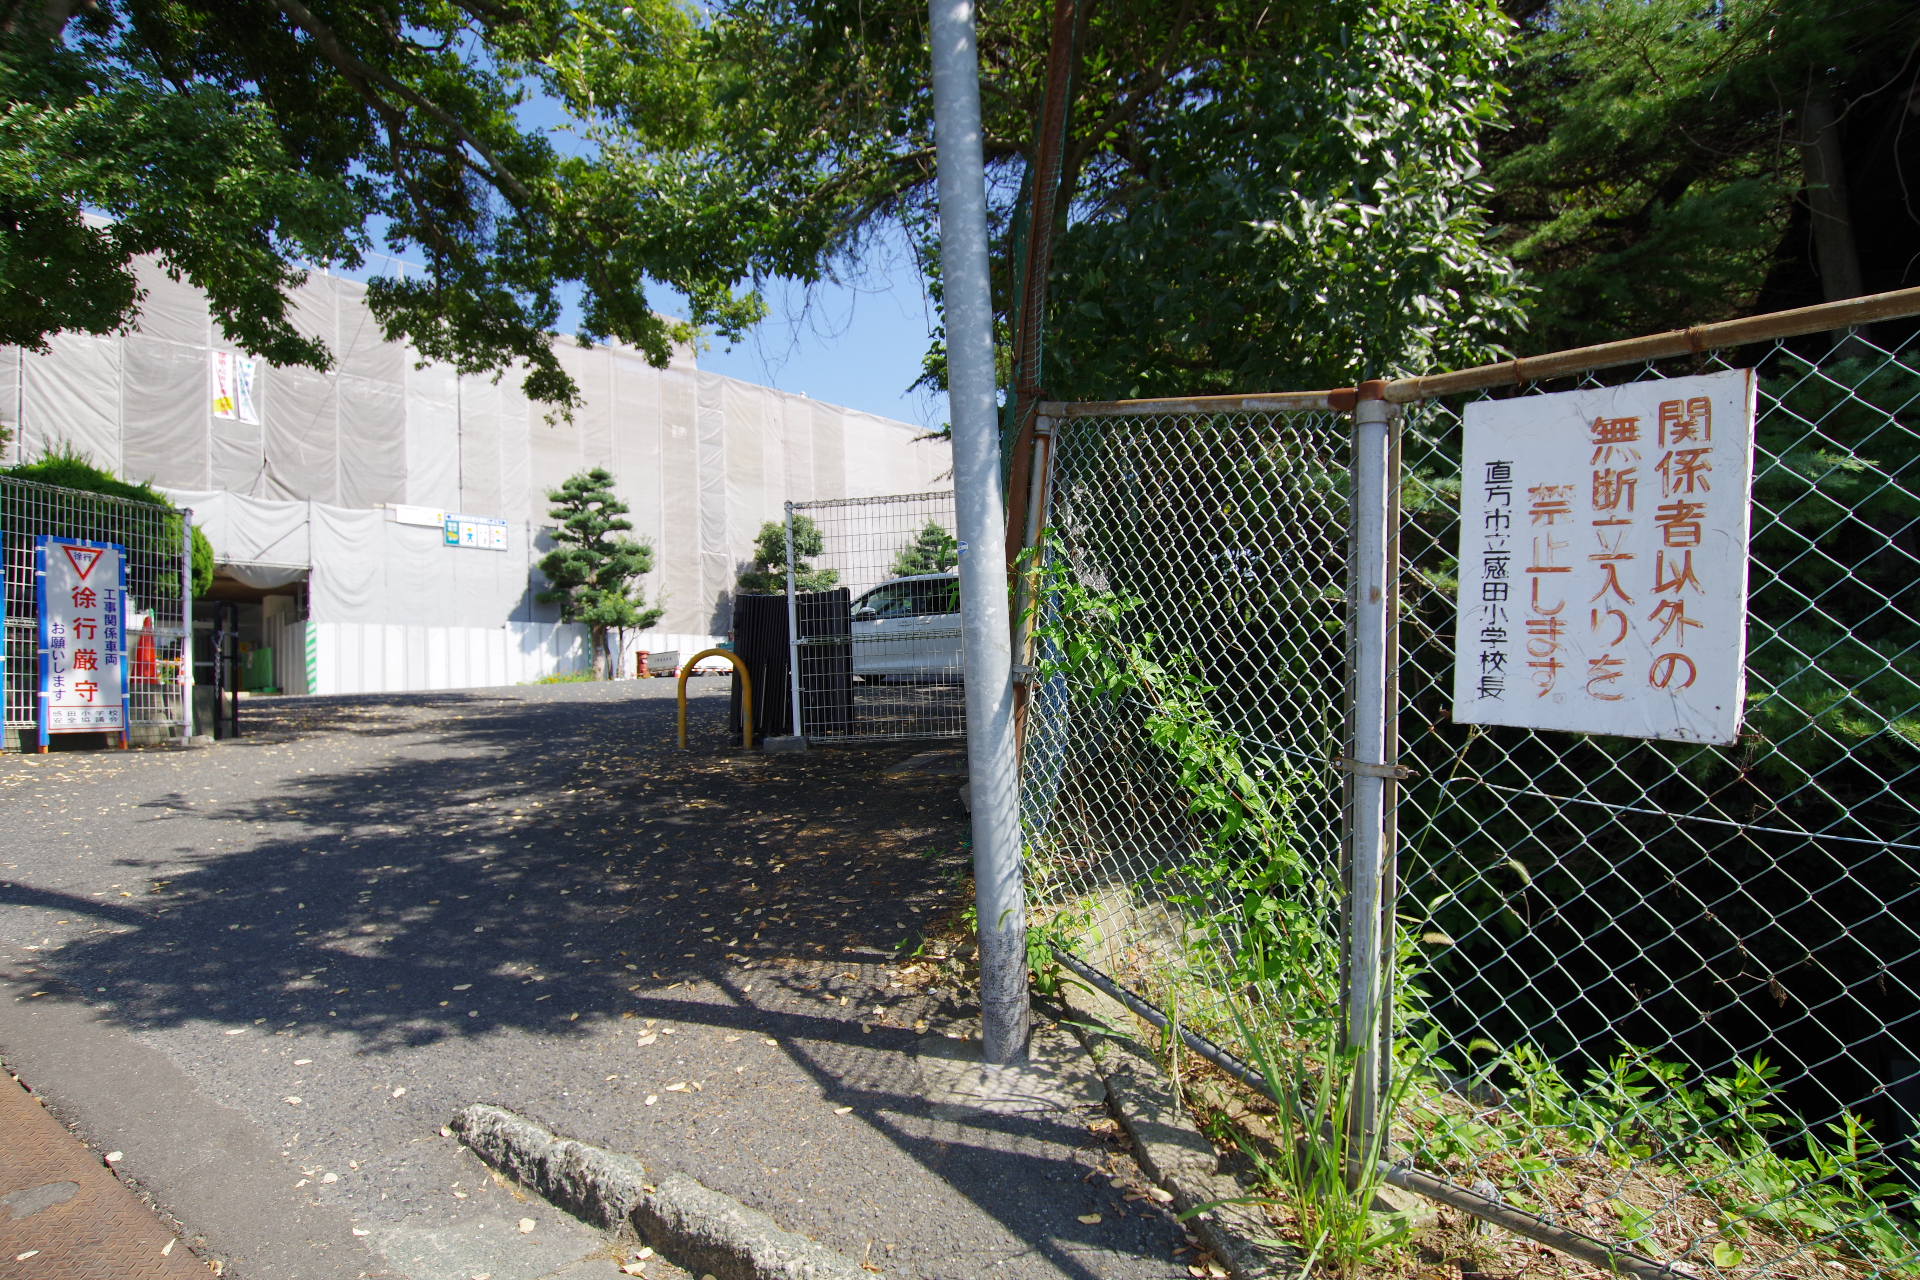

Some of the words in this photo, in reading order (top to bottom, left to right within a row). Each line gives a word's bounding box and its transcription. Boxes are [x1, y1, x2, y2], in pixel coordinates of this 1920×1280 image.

[73, 551, 93, 562] 徐行
[103, 588, 118, 666] 工事関係車両
[1477, 459, 1514, 701] 直方市立感田小学校長
[1525, 481, 1576, 698] 禁止します
[1586, 416, 1642, 701] 無断立入りを
[1647, 396, 1713, 693] 関係者以外の
[50, 622, 66, 701] お願いします
[71, 585, 99, 703] 徐行厳守
